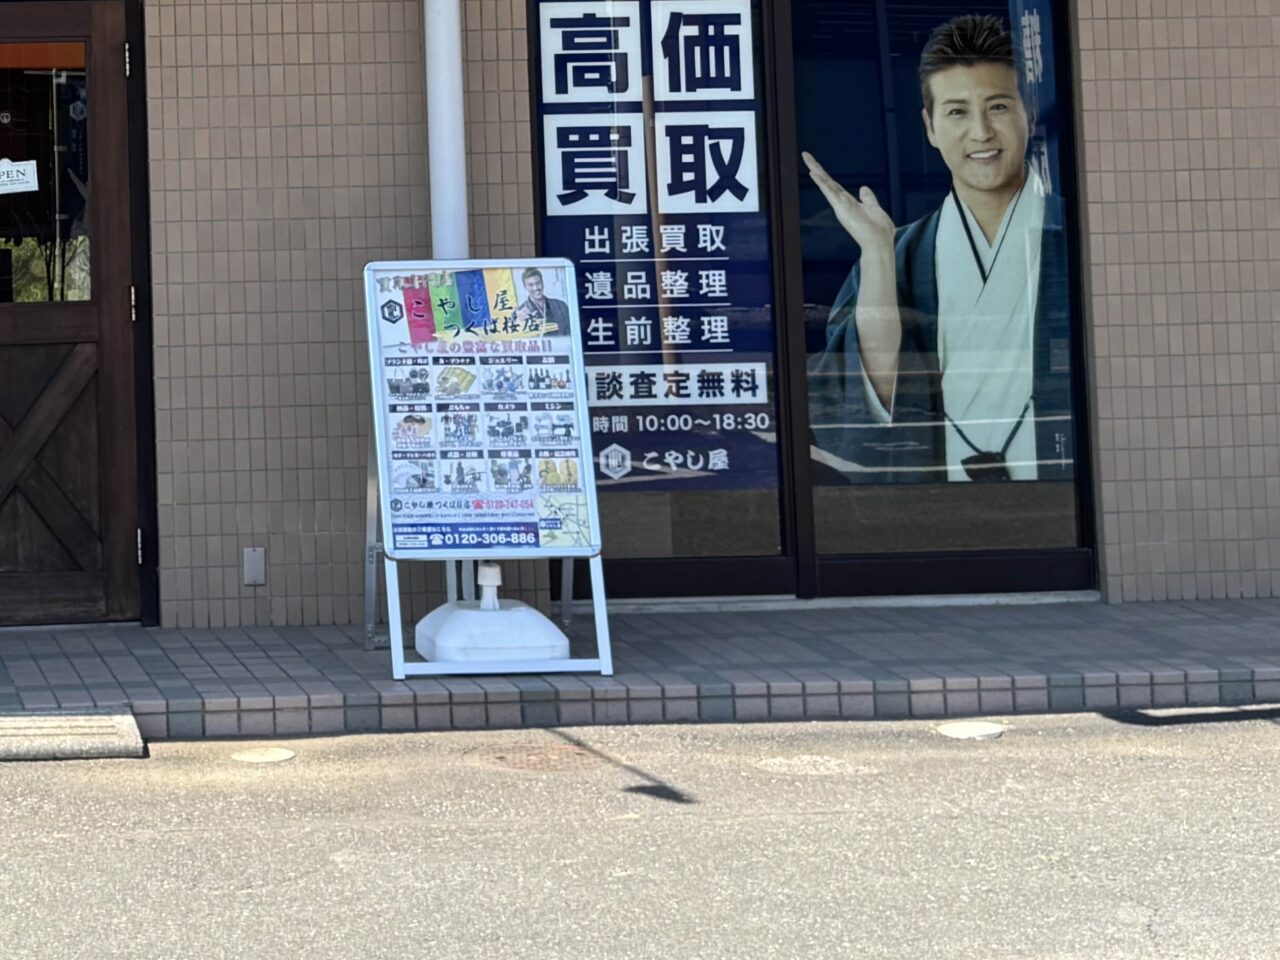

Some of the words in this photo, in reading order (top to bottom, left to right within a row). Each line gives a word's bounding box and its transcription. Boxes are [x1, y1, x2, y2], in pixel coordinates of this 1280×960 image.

[549, 11, 743, 95] 高価
[556, 123, 750, 207] 買取
[584, 224, 726, 254] 出張買取
[585, 270, 728, 300] 遺品整理
[412, 289, 513, 319] こやし屋
[443, 311, 542, 338] つくば桜店
[587, 316, 730, 345] 生前整理
[586, 369, 758, 401] 談査定無料
[593, 416, 629, 433] 時間
[642, 448, 730, 472] こやし屋
[445, 533, 536, 545] 0120-306-886
